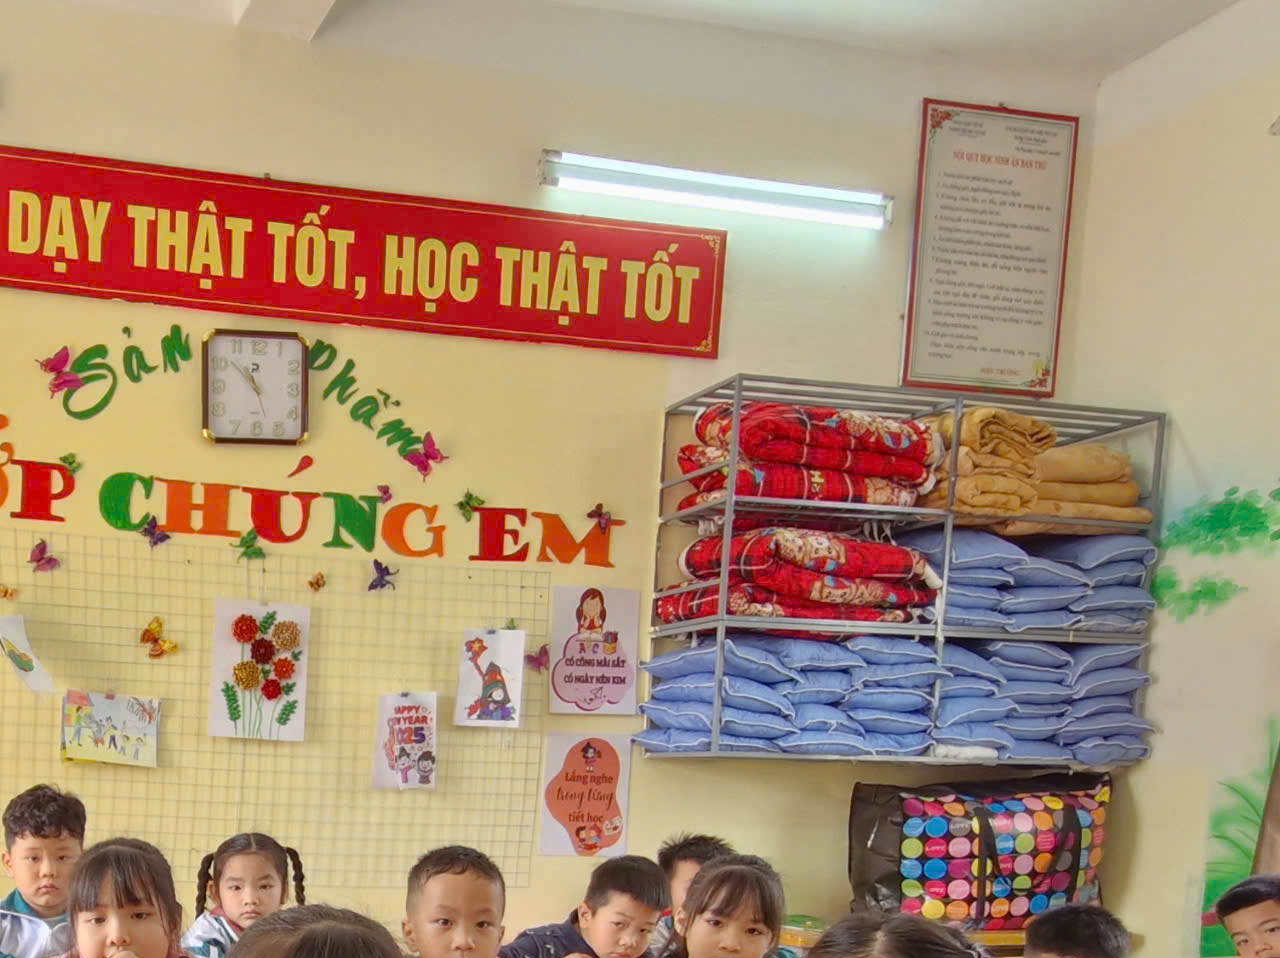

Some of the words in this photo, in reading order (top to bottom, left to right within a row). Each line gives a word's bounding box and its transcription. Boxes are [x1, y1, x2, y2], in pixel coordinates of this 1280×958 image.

[8, 189, 112, 273] DẠY
[127, 200, 253, 290] THẬT
[267, 204, 367, 300] TỐT,
[384, 234, 480, 313] HỌC
[495, 240, 608, 326] THẬT
[620, 243, 701, 324] TỐT
[99, 455, 447, 558] CHÚNG
[468, 506, 626, 568] EM
[590, 773, 613, 786] nghe
